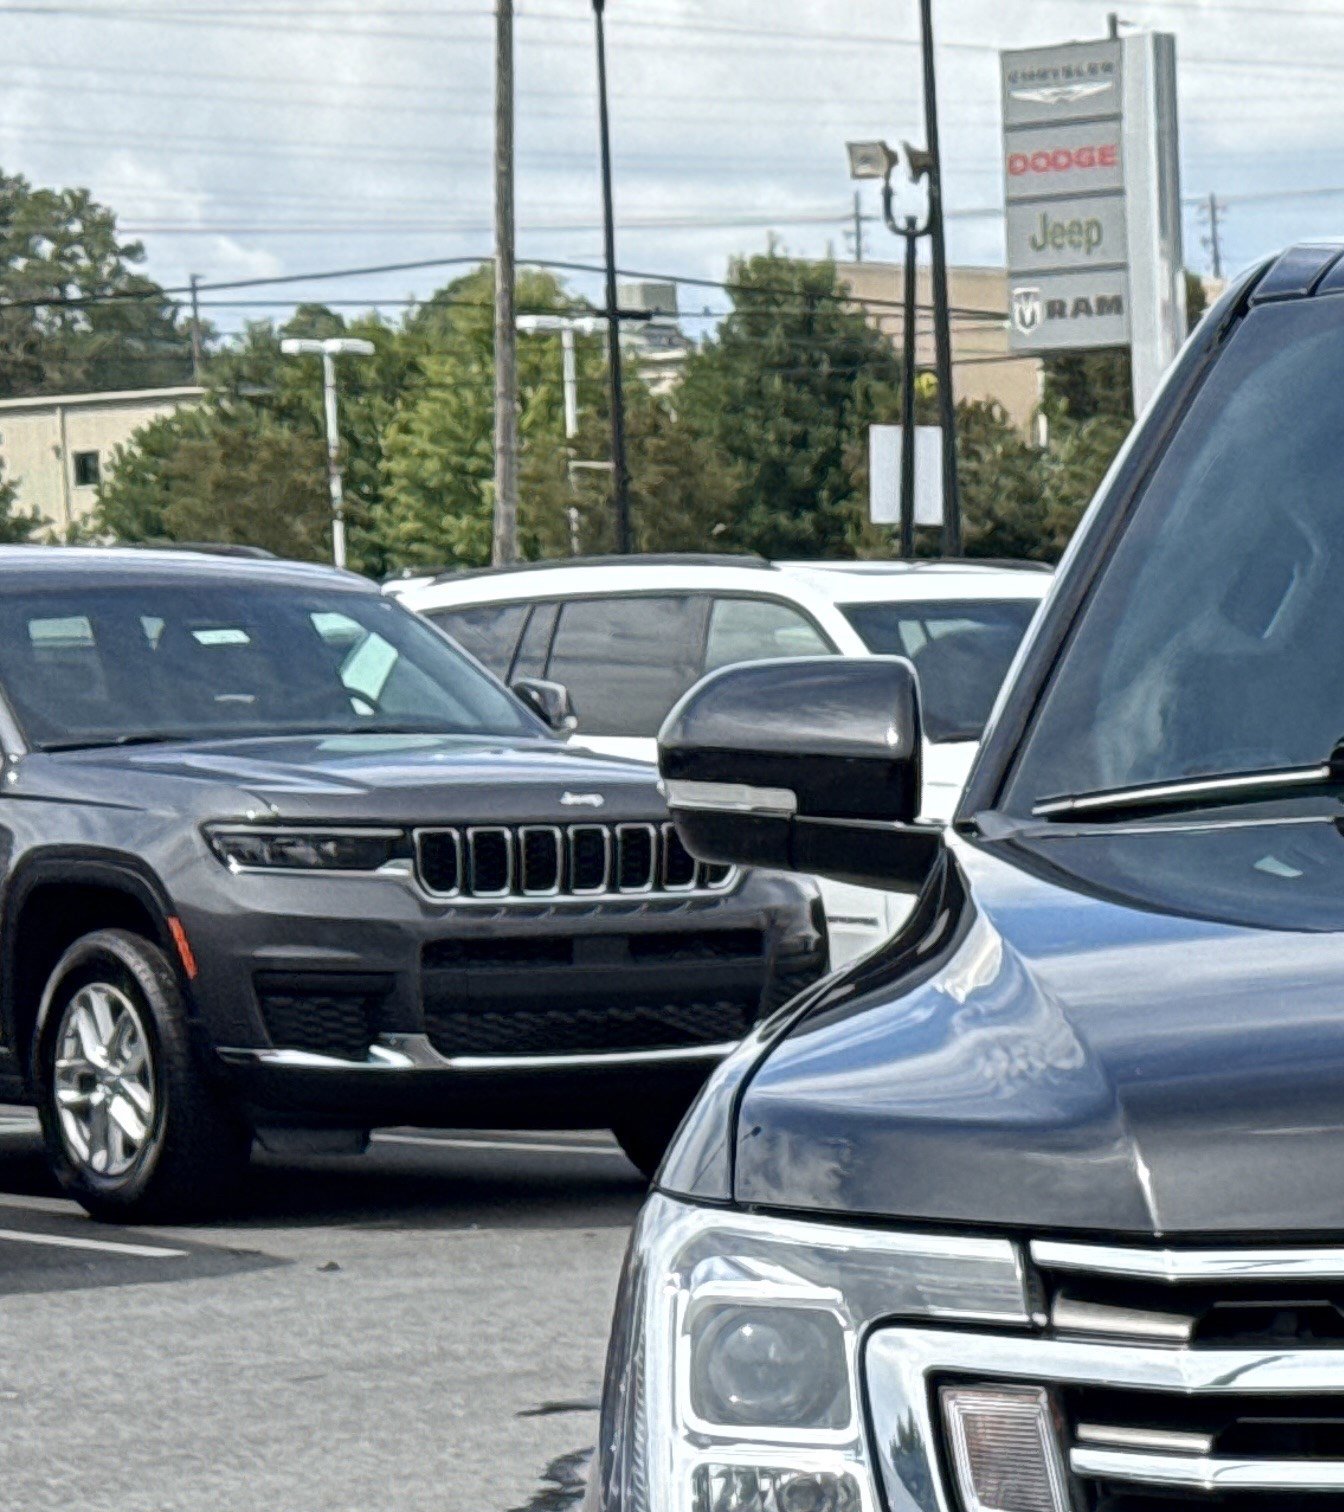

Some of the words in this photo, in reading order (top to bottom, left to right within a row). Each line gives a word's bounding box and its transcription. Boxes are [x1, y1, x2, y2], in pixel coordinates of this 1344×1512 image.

[1008, 144, 1117, 176] DODGE
[1028, 211, 1104, 255] Jeep
[1046, 295, 1124, 320] RAM
